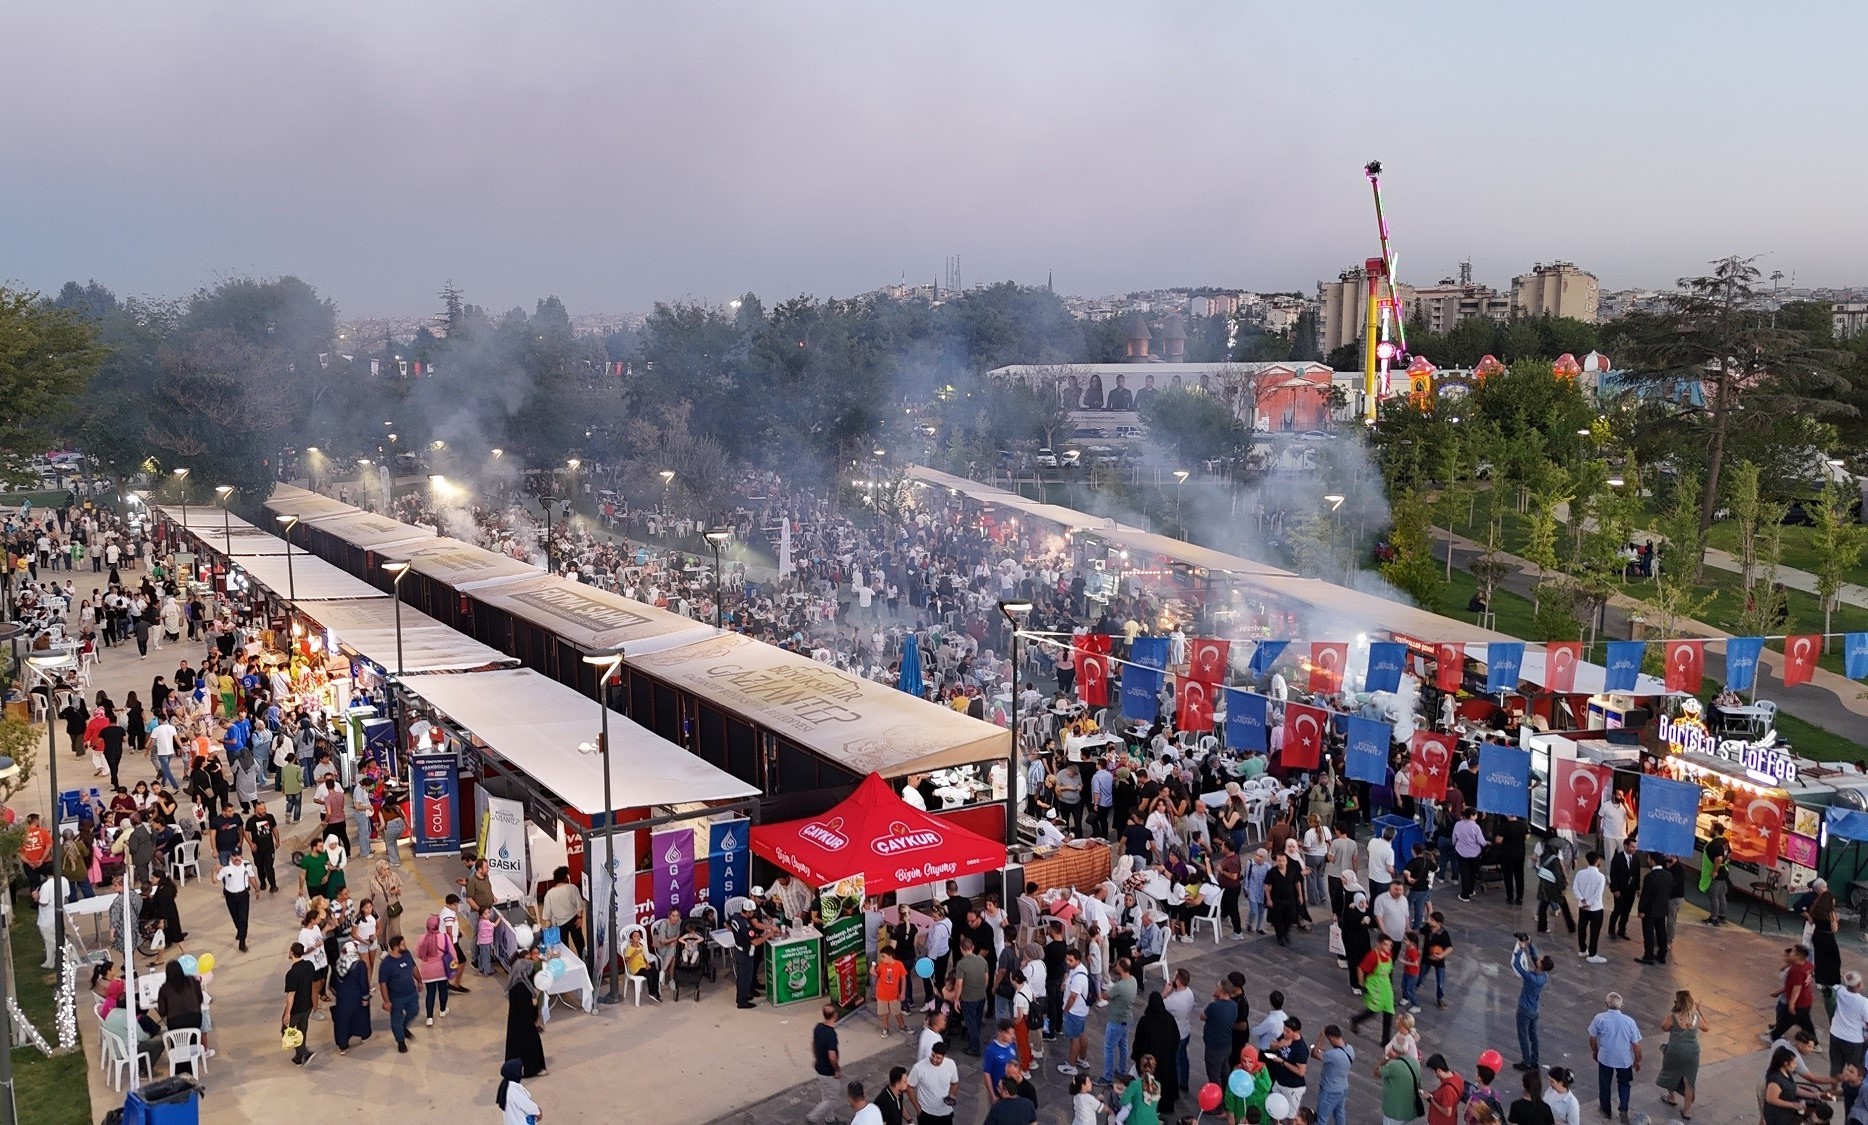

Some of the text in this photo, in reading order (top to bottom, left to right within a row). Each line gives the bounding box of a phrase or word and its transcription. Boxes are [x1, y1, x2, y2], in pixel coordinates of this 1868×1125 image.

[1659, 715, 1798, 782] Barista's Coffee
[433, 803, 443, 833] COLA
[803, 825, 844, 850] ÇAYKUR
[877, 833, 938, 853] ÇAYKUR
[489, 859, 520, 870] GASKİ
[895, 867, 923, 883] Bizim
